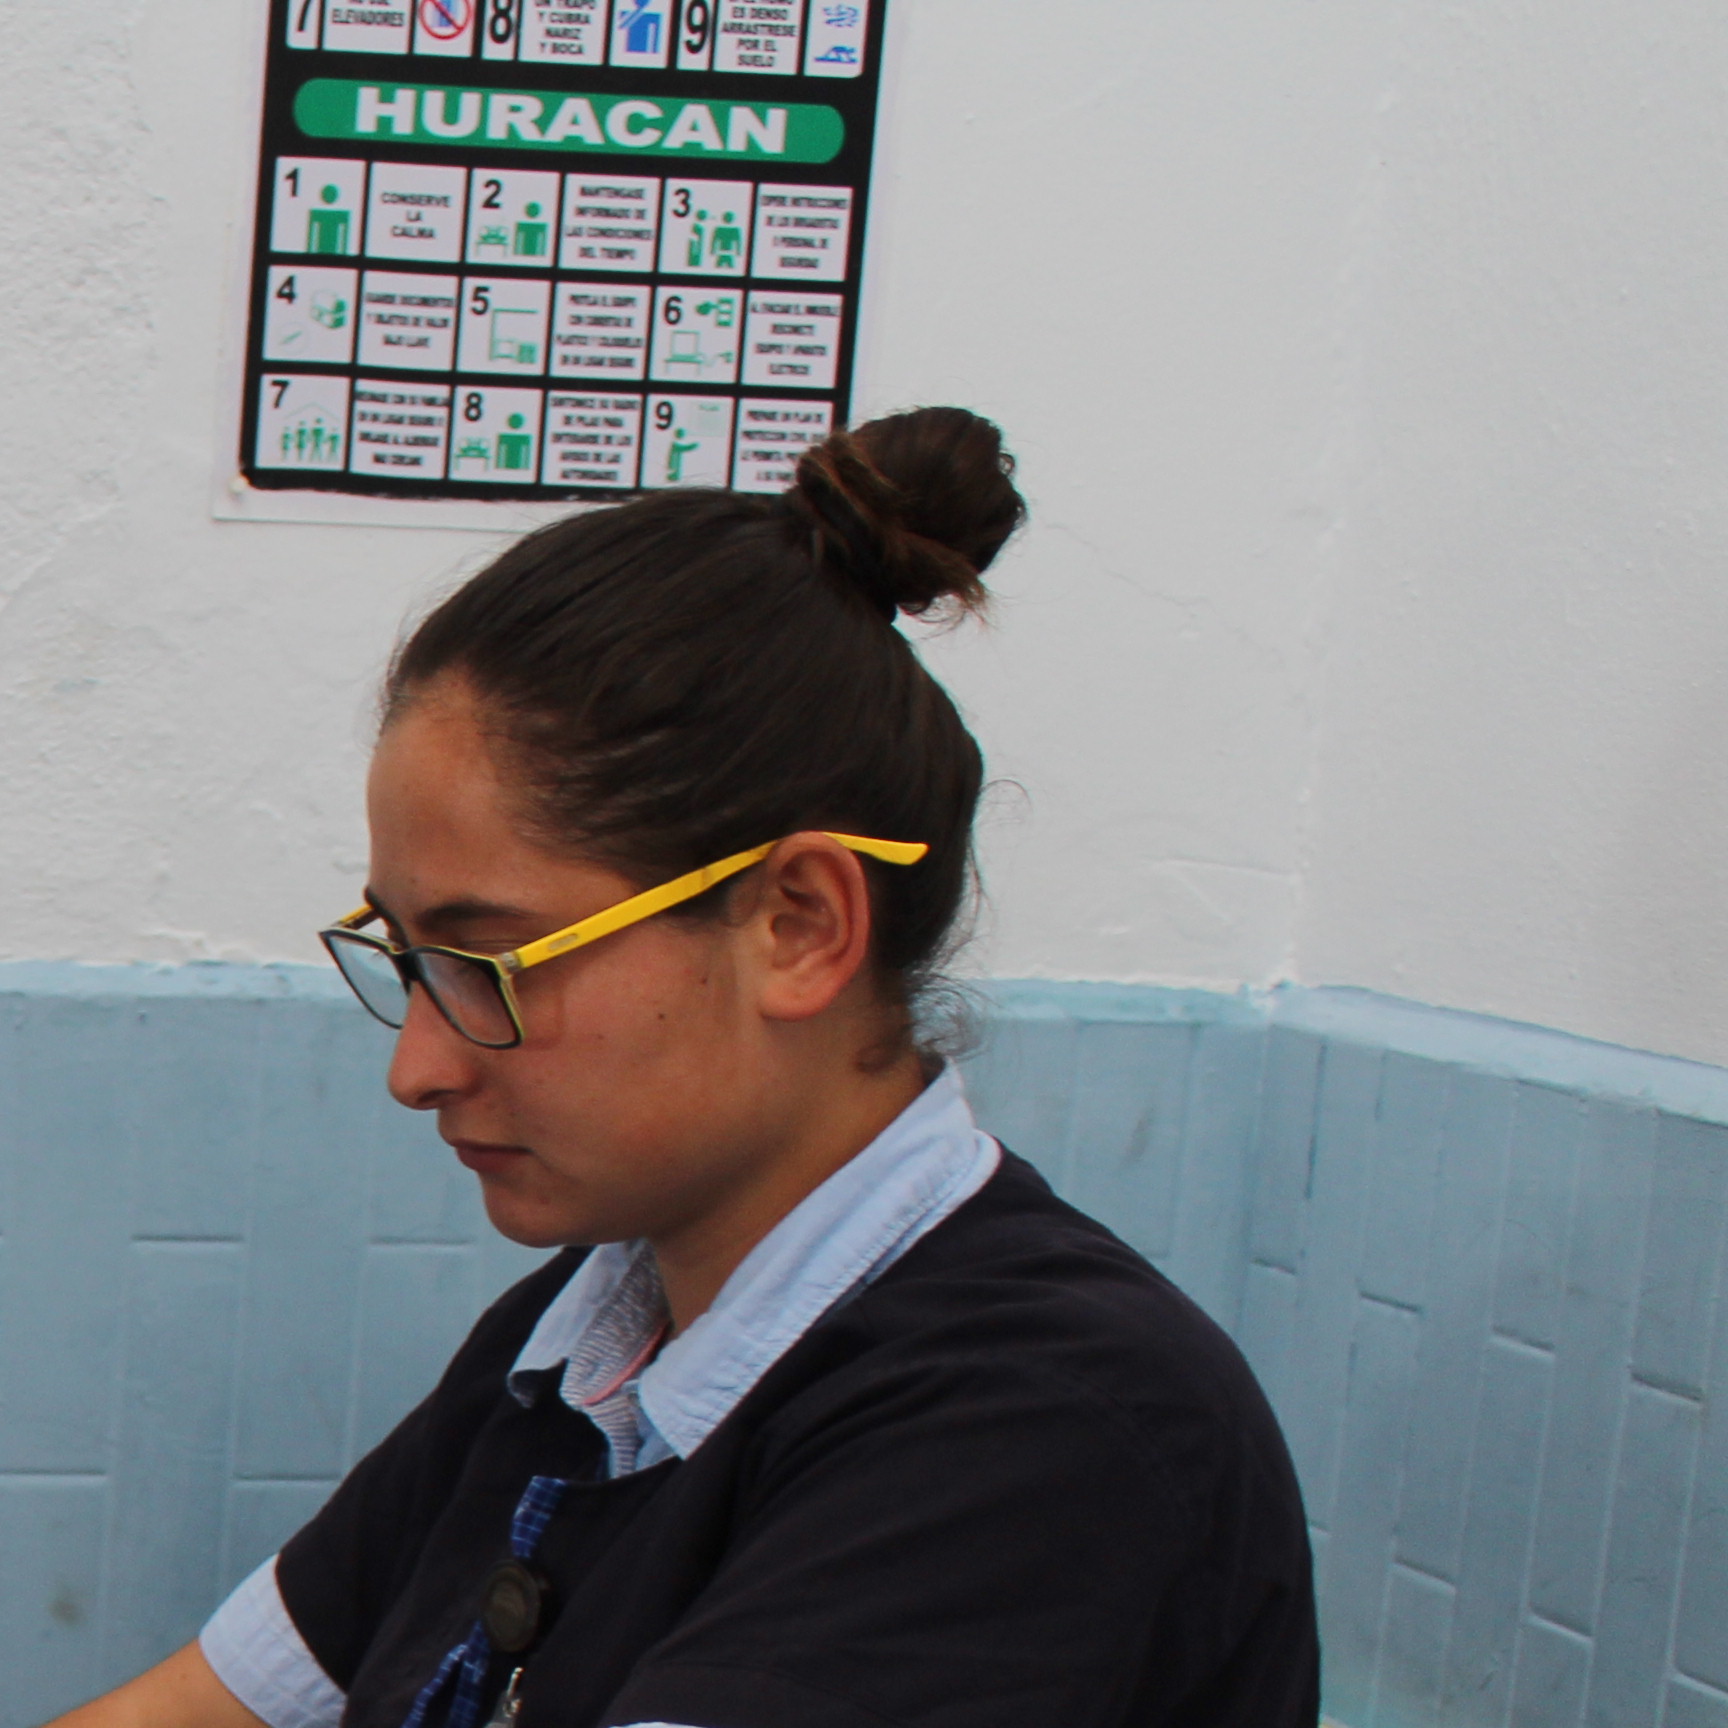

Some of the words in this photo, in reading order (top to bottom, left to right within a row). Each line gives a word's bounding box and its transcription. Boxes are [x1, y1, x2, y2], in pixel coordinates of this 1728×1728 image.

[331, 8, 404, 27] ELEVADORES
[548, 11, 591, 25] CUBRA
[684, 0, 710, 54] 9
[748, 7, 788, 21] DENSO
[544, 26, 583, 41] NARIZ
[735, 38, 760, 52] POR
[763, 40, 778, 52] EL
[551, 42, 585, 56] BOCA
[736, 54, 775, 68] SUELO
[354, 86, 789, 154] HURACAN
[284, 168, 301, 197] 1
[482, 179, 503, 210] 2
[381, 191, 452, 209] CONSERVE
[672, 187, 692, 218] 3
[406, 209, 423, 223] LA
[390, 224, 436, 241] CALMA
[275, 274, 297, 304] 4
[470, 285, 490, 316] 5
[663, 295, 683, 326] 6
[270, 379, 291, 409] 7
[464, 391, 484, 423] 8
[654, 400, 674, 431] 9
